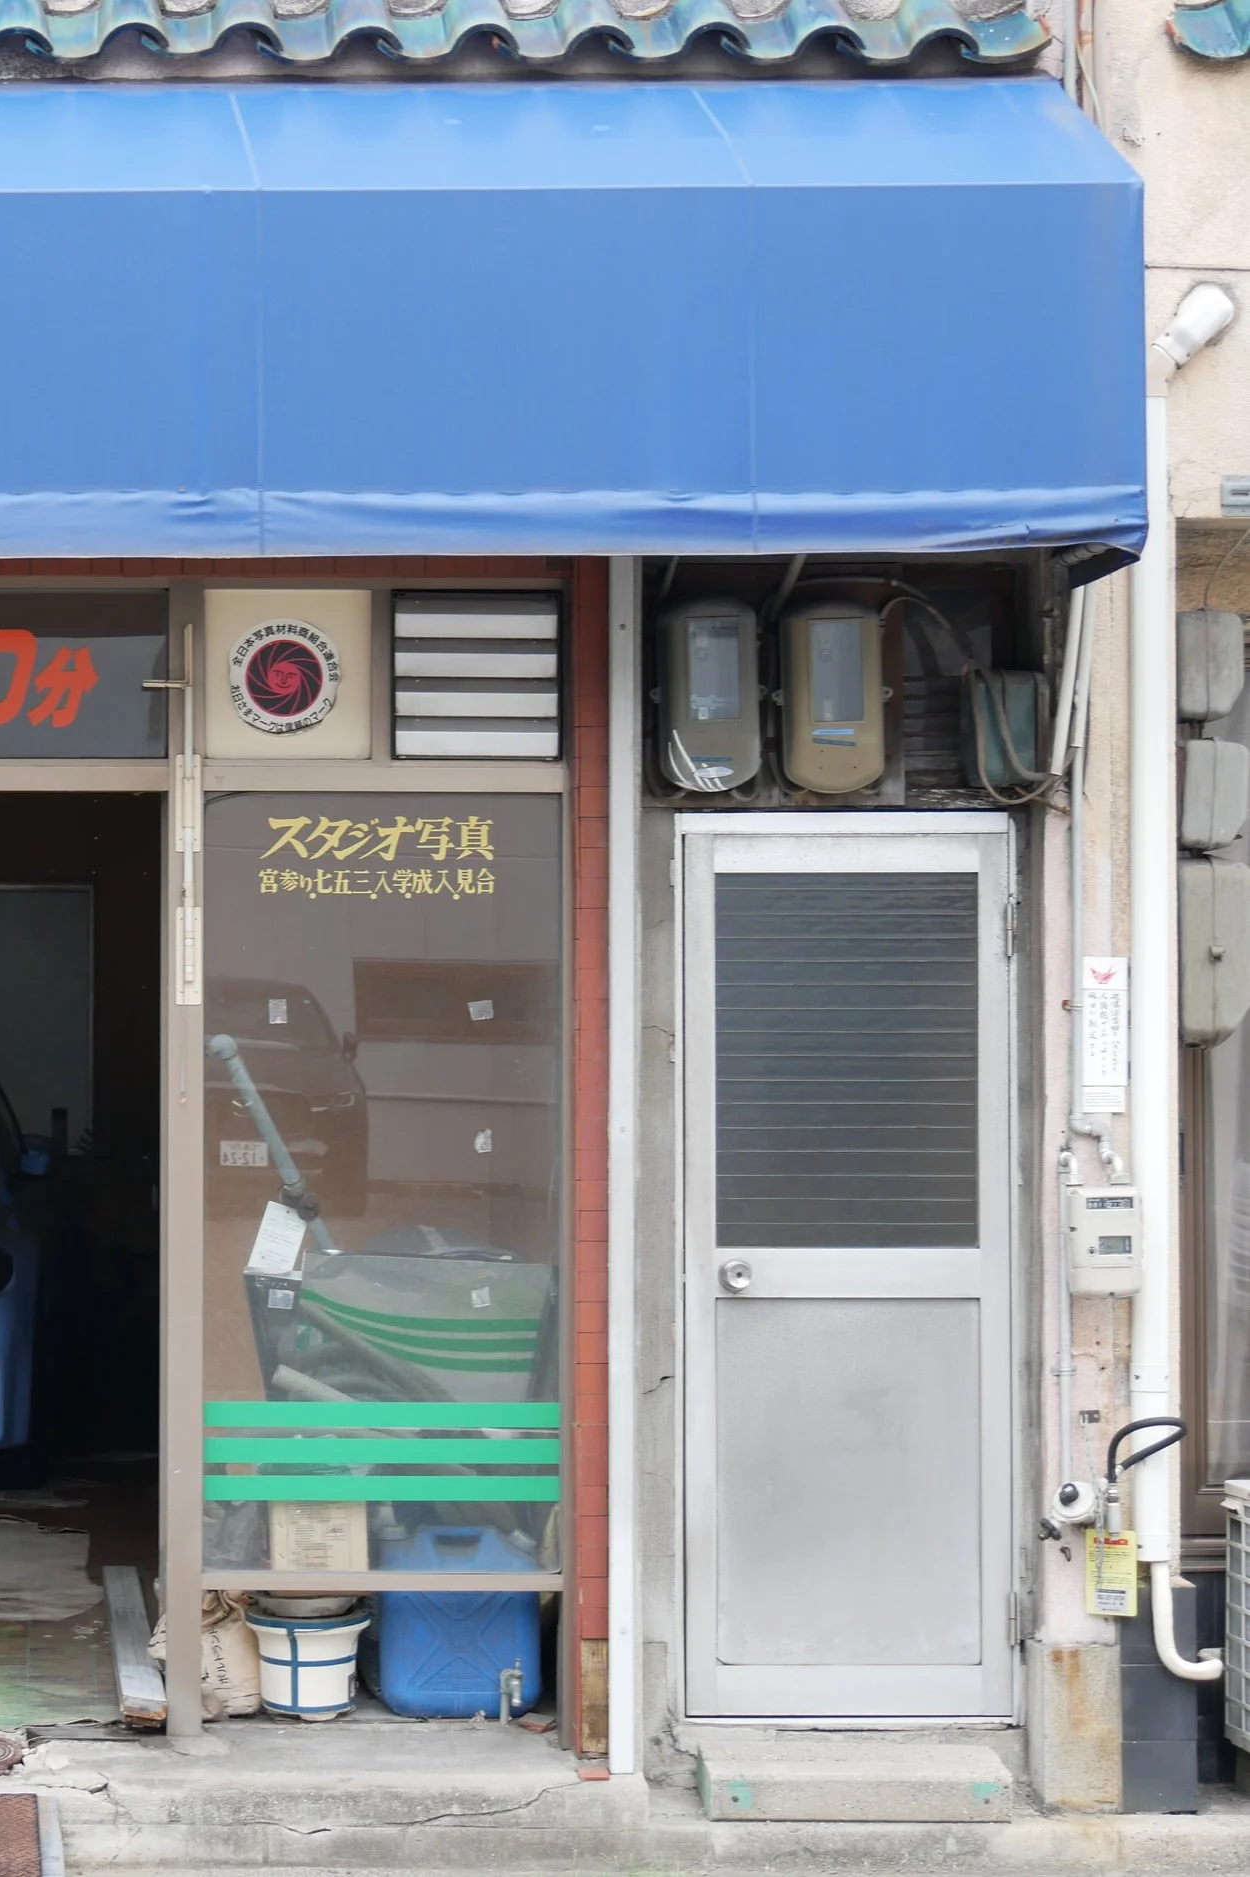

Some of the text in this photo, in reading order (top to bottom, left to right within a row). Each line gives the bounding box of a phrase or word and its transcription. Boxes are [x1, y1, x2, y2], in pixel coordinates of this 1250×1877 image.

[258, 815, 495, 861] スタジオ写真
